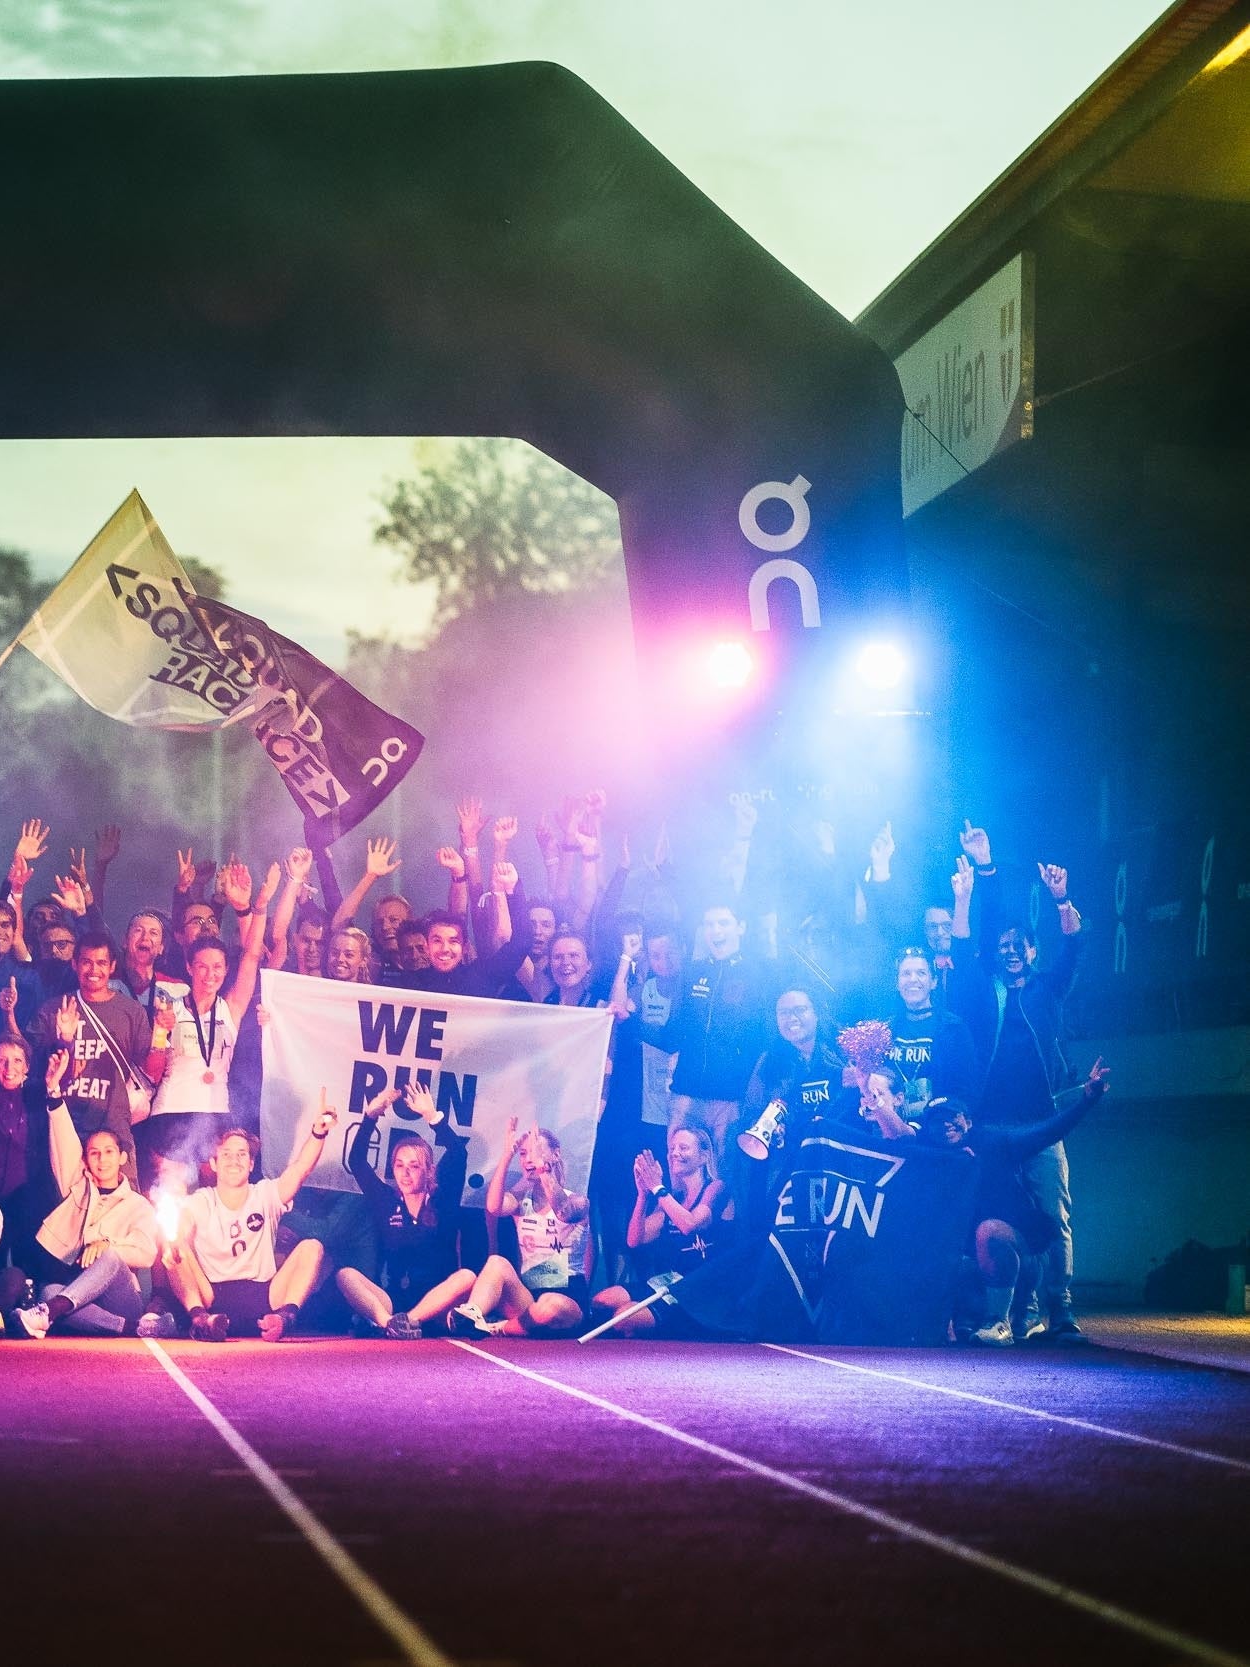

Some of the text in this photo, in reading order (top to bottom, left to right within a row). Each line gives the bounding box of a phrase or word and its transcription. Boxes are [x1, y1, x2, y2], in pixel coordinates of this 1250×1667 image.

[358, 1000, 448, 1061] WE
[905, 1045, 931, 1062] RUN
[348, 1060, 478, 1127] RUN
[802, 1086, 830, 1104] RUN
[775, 1177, 885, 1238] E RUN
